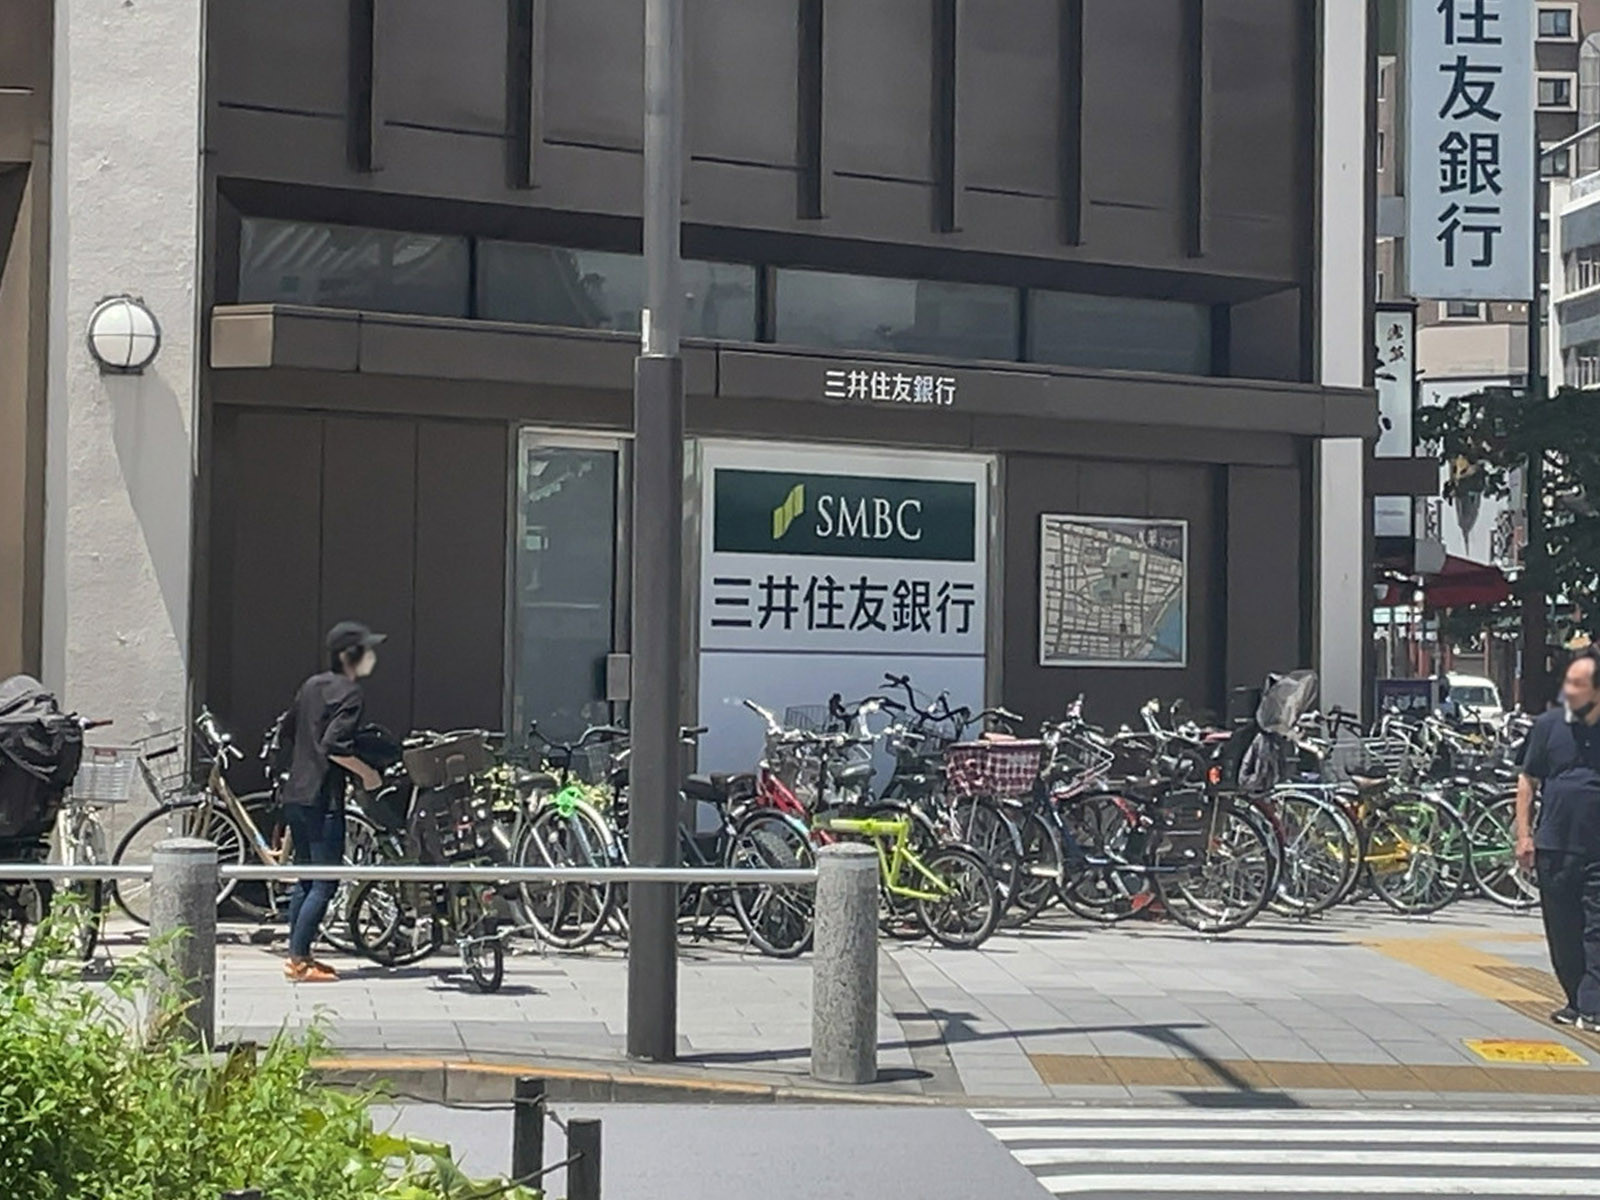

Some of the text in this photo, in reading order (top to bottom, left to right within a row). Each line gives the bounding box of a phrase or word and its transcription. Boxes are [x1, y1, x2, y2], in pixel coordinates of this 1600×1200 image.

[825, 370, 956, 405] 三井住友銀行
[816, 495, 922, 541] SMBC
[711, 575, 975, 634] 三井住友銀行
